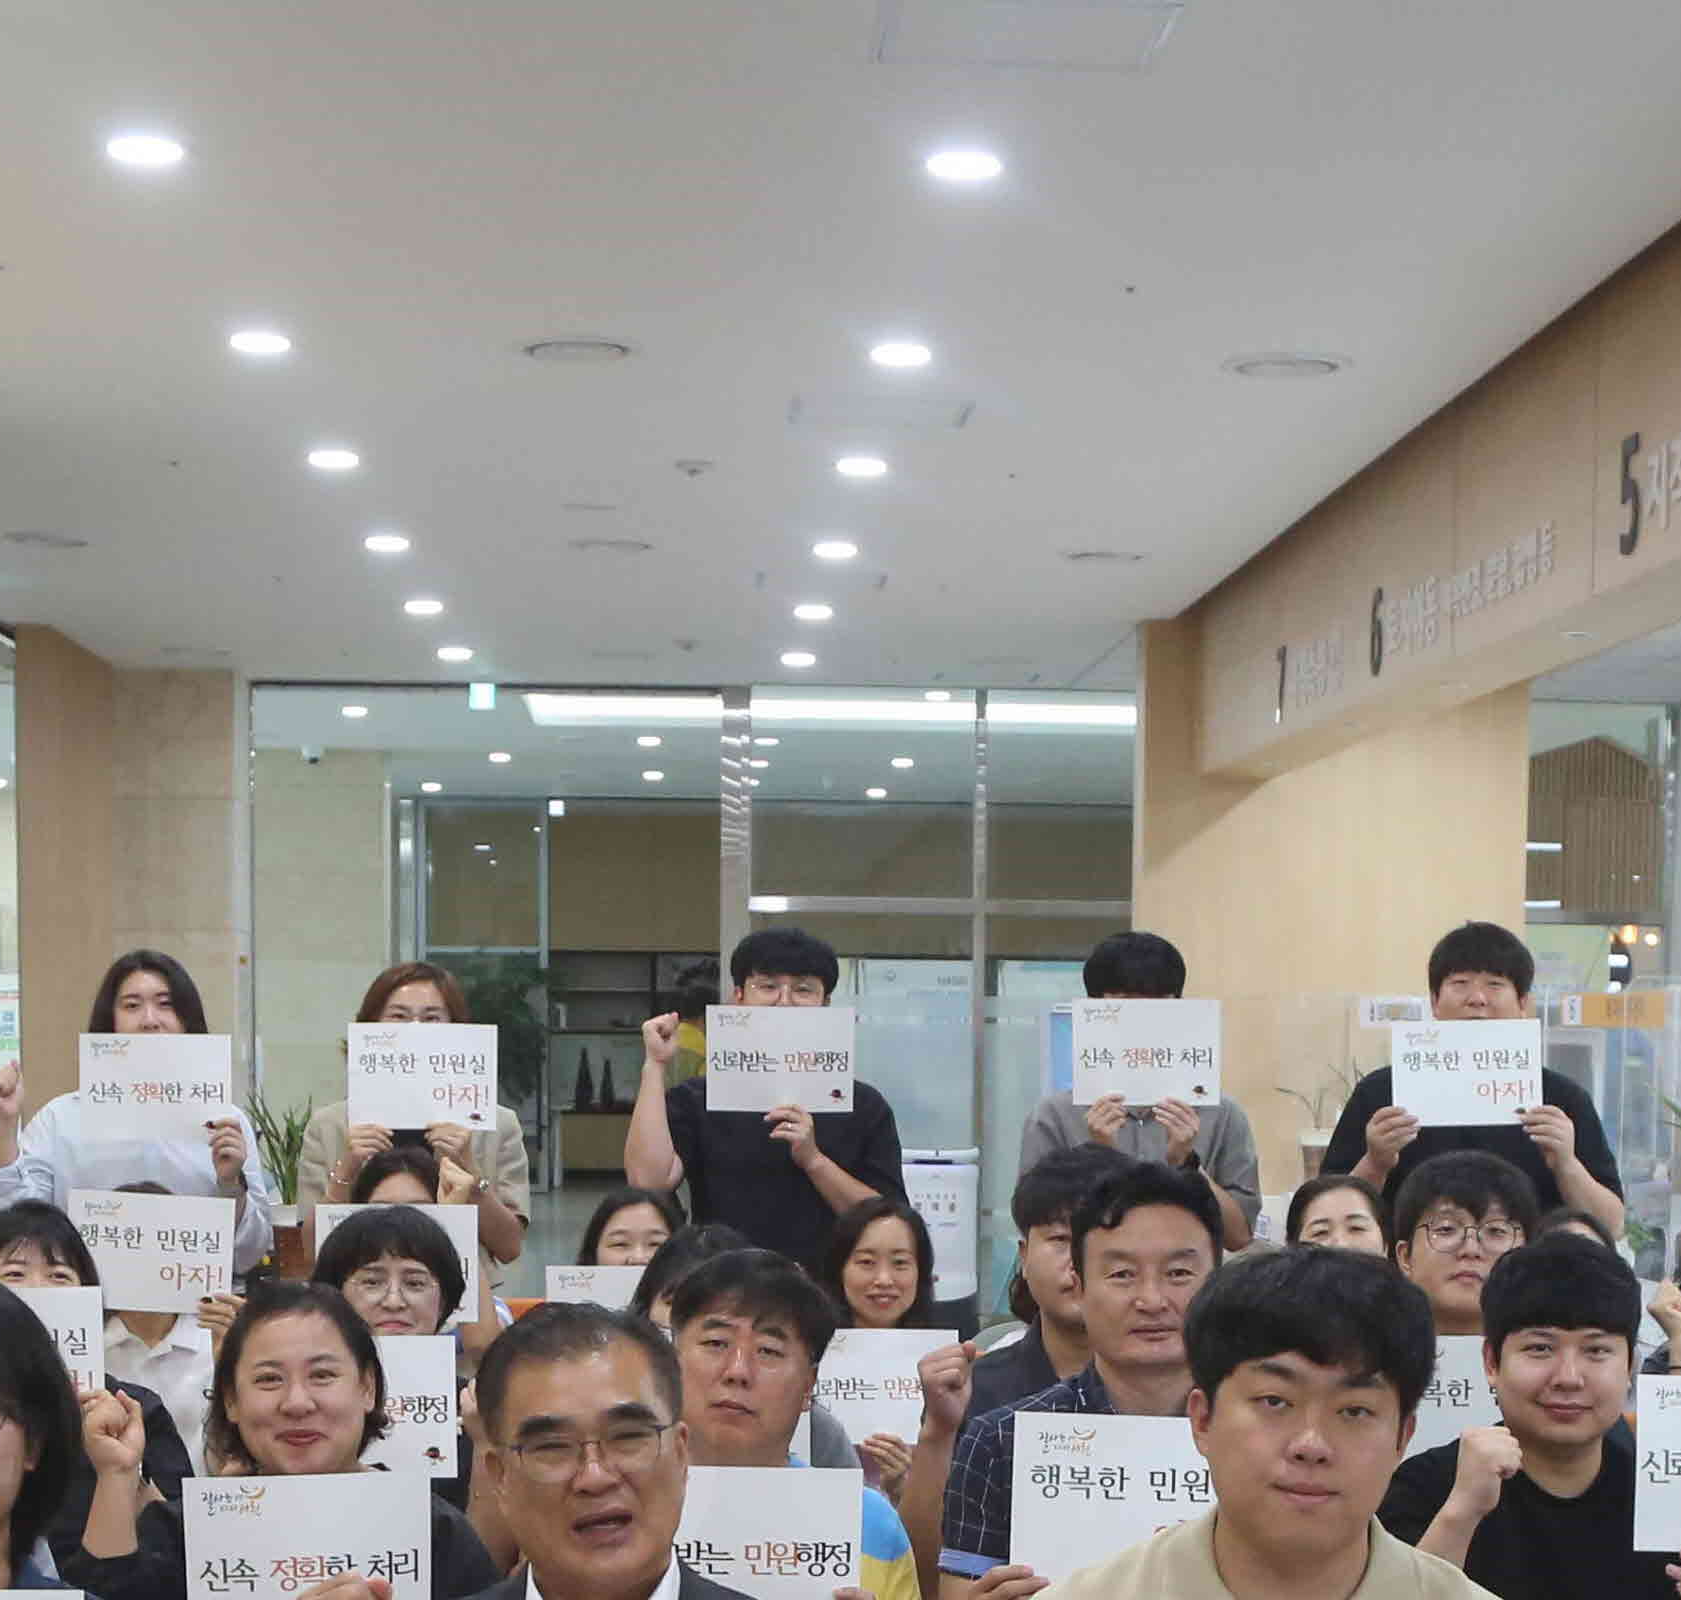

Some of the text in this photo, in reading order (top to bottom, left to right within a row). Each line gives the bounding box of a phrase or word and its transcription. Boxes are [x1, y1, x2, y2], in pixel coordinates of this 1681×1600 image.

[1619, 431, 1640, 556] 5
[1370, 586, 1383, 678] 6
[359, 1051, 488, 1076] 행복한 민원실
[710, 1048, 850, 1074] 신뢰받는 민원행정
[1080, 1046, 1213, 1071] 신속 정확한 처리
[1401, 1049, 1531, 1073] 행복한 민원실
[87, 1080, 225, 1104] 신속 정확한 처리
[431, 1083, 489, 1109] 아자!
[1476, 1080, 1536, 1104] 아자!
[80, 1223, 221, 1255] 행복한 민원실
[159, 1262, 224, 1293] 아자!
[815, 1377, 880, 1401] 뢰받는
[1423, 1378, 1475, 1408] 복한
[1030, 1463, 1212, 1503] 행복한 민원
[199, 1558, 259, 1592] 신속
[367, 1547, 419, 1585] 처리
[744, 1541, 852, 1578] 민원행정
